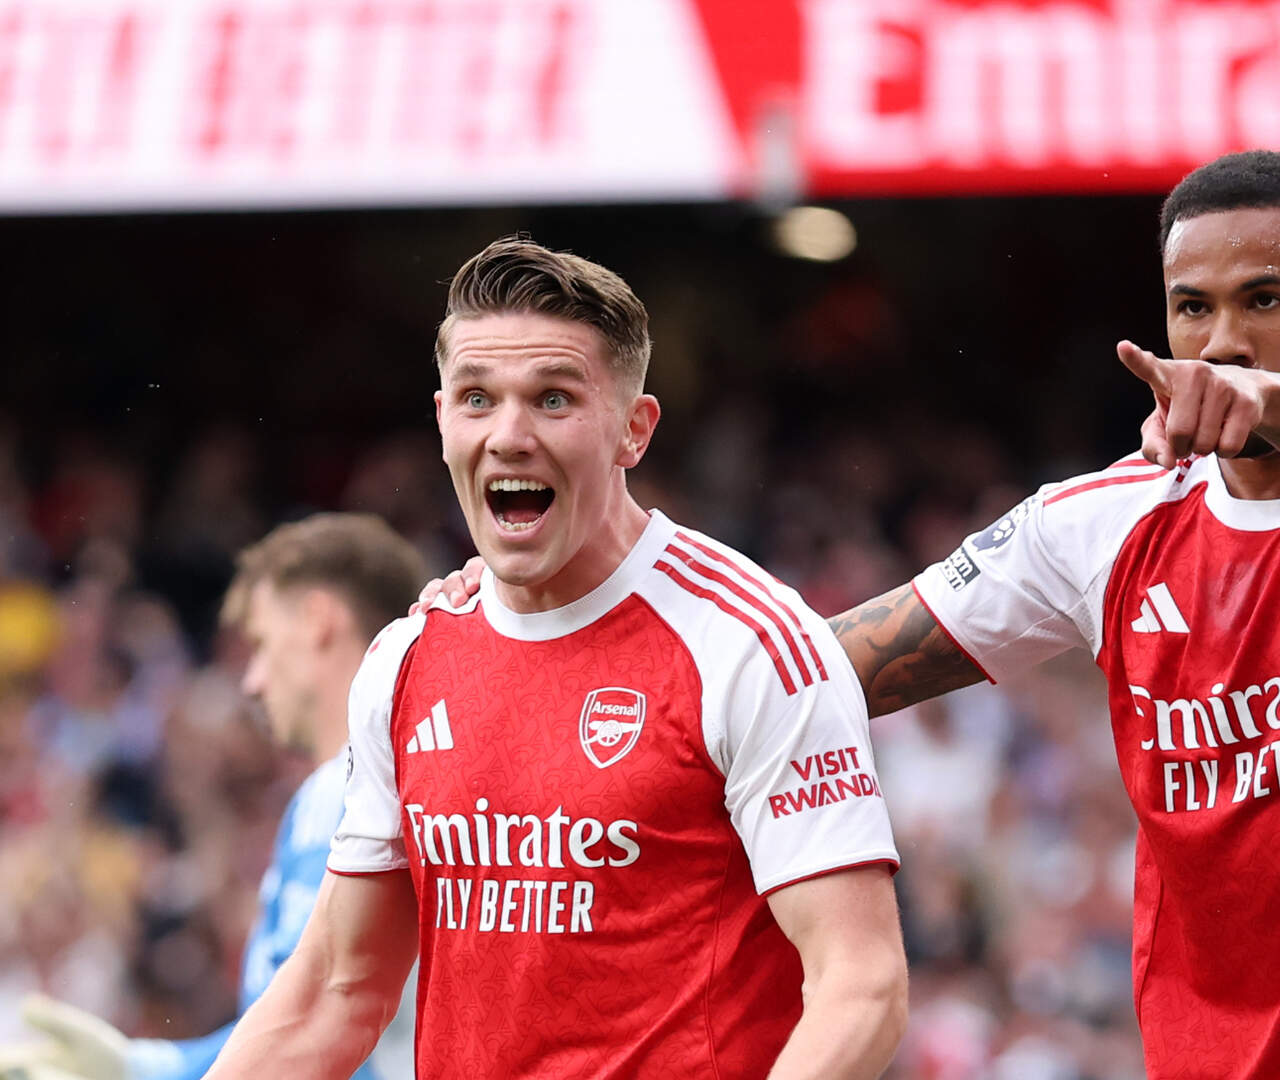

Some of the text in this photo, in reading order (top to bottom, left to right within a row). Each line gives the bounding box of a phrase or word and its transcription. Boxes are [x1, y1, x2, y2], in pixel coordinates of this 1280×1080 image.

[591, 700, 638, 717] Arsenal
[790, 746, 860, 781] VISIT
[1163, 759, 1218, 813] FLY
[404, 797, 641, 868] Emirates
[435, 877, 594, 934] FLY BETTER
